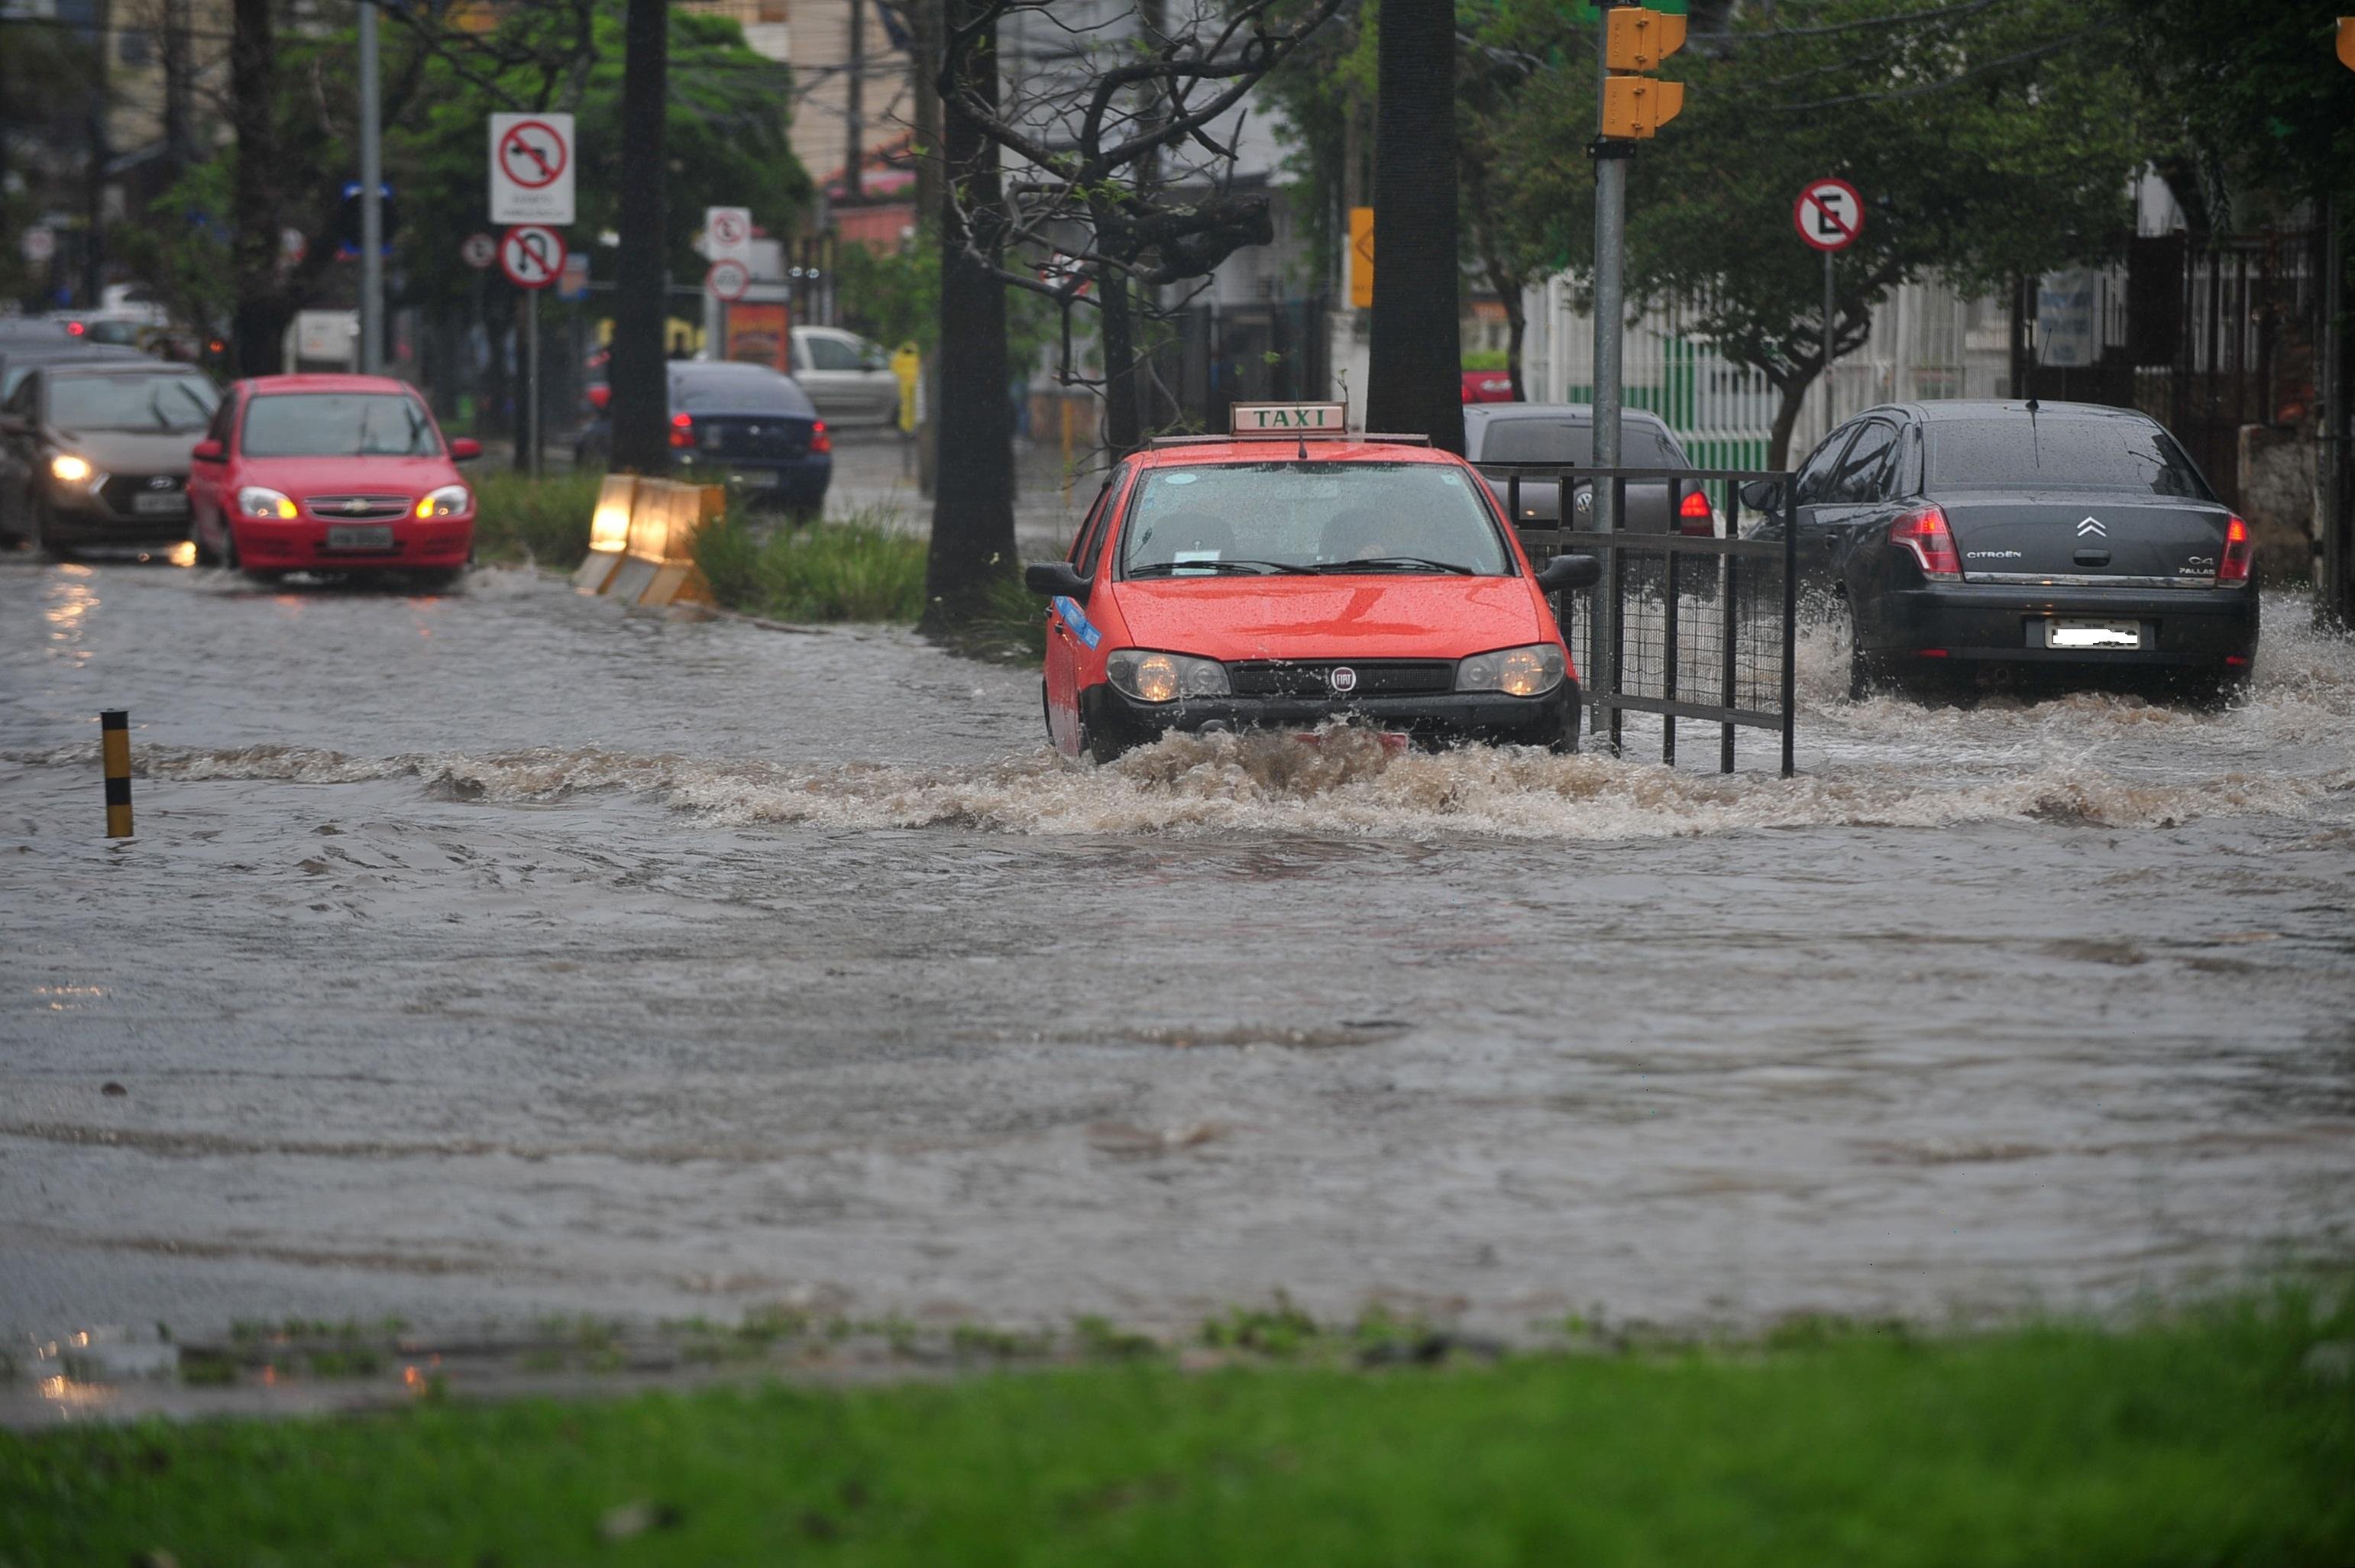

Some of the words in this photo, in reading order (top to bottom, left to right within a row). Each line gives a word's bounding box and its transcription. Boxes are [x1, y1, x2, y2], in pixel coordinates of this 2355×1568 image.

[1818, 195, 1842, 234] E
[1254, 409, 1324, 427] TAXI
[1966, 550, 2022, 558] CITROËN
[2188, 556, 2213, 566] C4
[1336, 674, 1351, 686] FIAT
